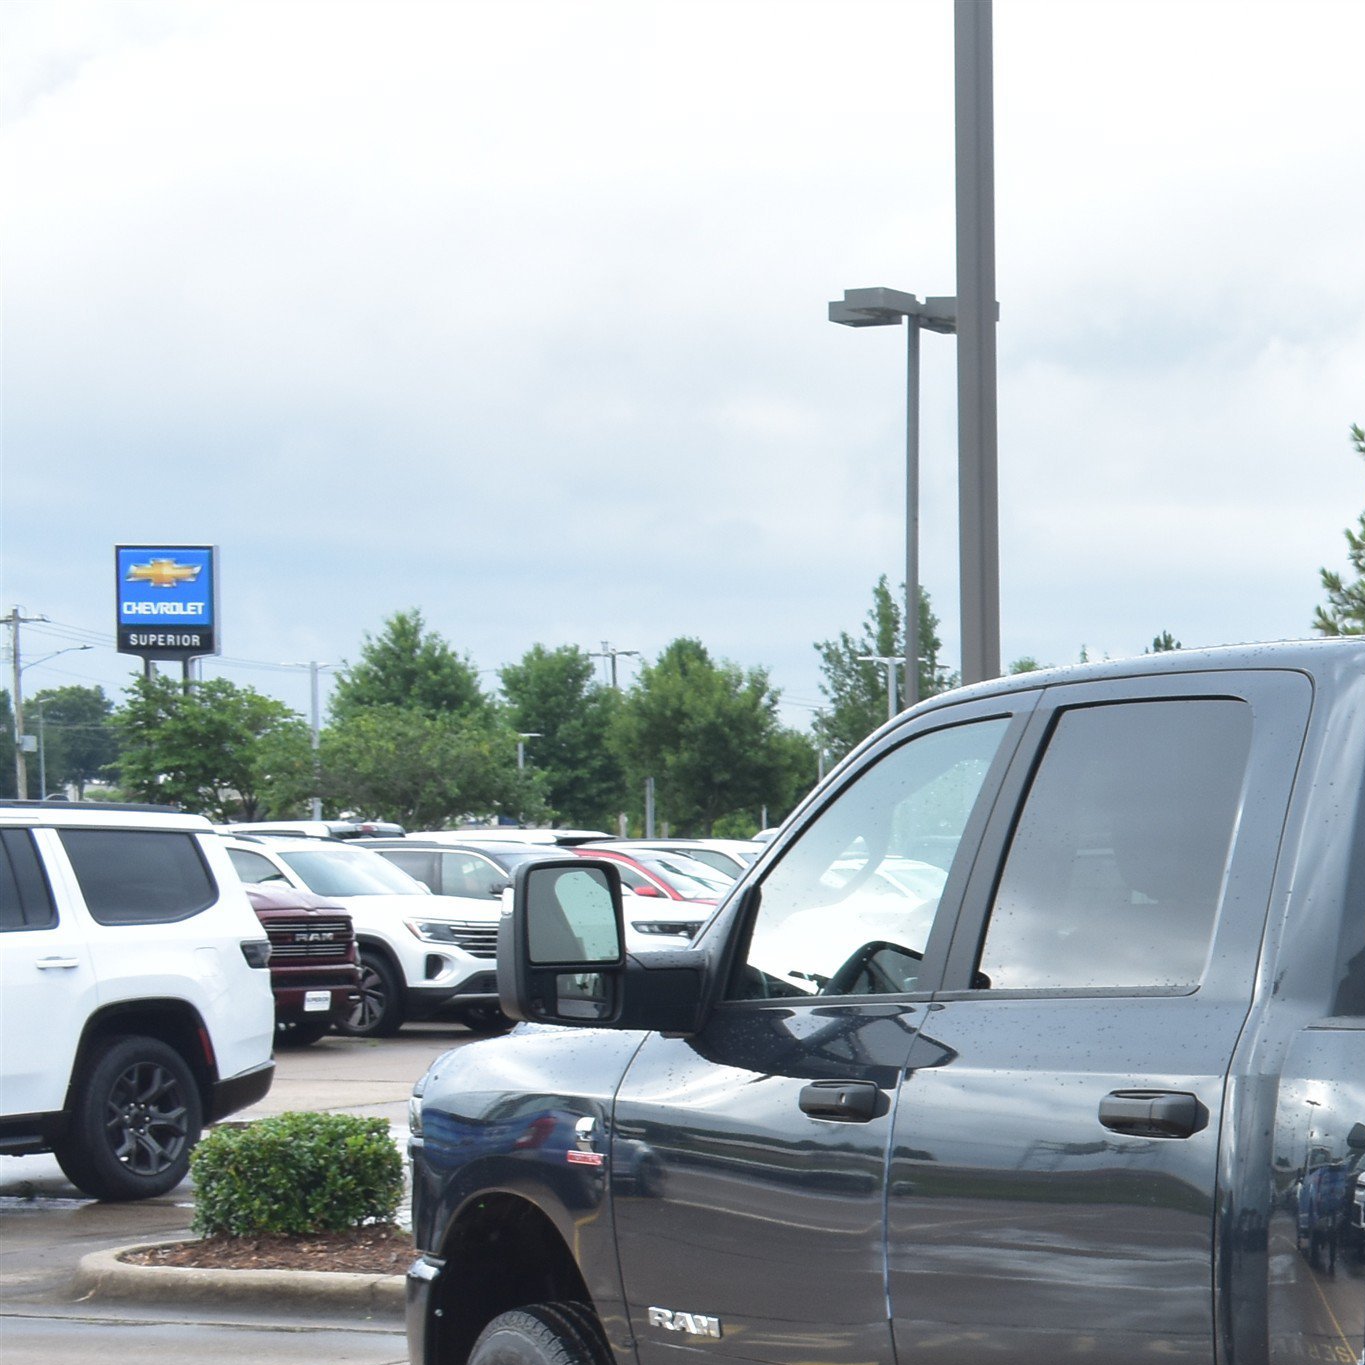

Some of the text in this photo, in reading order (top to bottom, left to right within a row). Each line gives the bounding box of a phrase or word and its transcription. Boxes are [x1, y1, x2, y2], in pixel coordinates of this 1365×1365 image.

[123, 602, 205, 615] CHEVROLET
[129, 634, 201, 646] SUPERIOR
[295, 932, 334, 942] RAM
[648, 1306, 721, 1338] RAM
